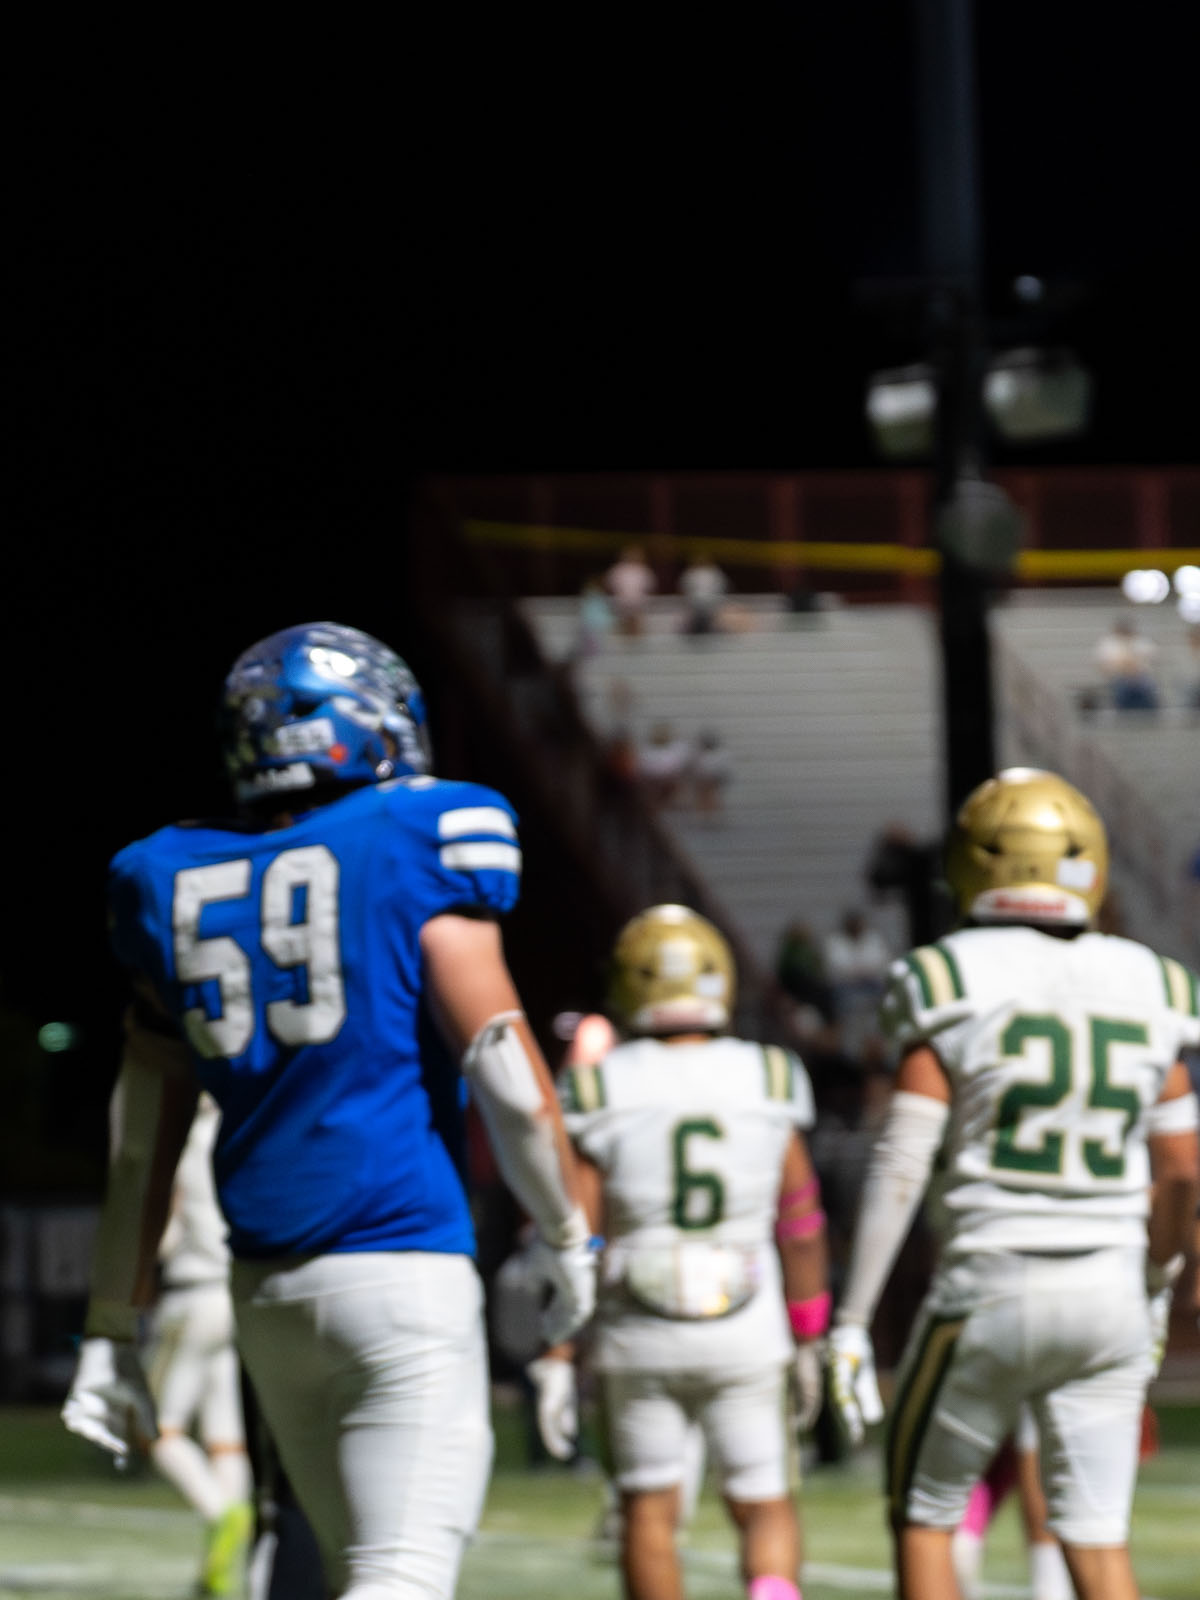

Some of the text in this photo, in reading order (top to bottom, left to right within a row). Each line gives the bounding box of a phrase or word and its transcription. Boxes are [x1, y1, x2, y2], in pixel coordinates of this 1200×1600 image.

[172, 844, 348, 1059] 59
[671, 1119, 724, 1231] 6
[990, 1014, 1150, 1180] 25
